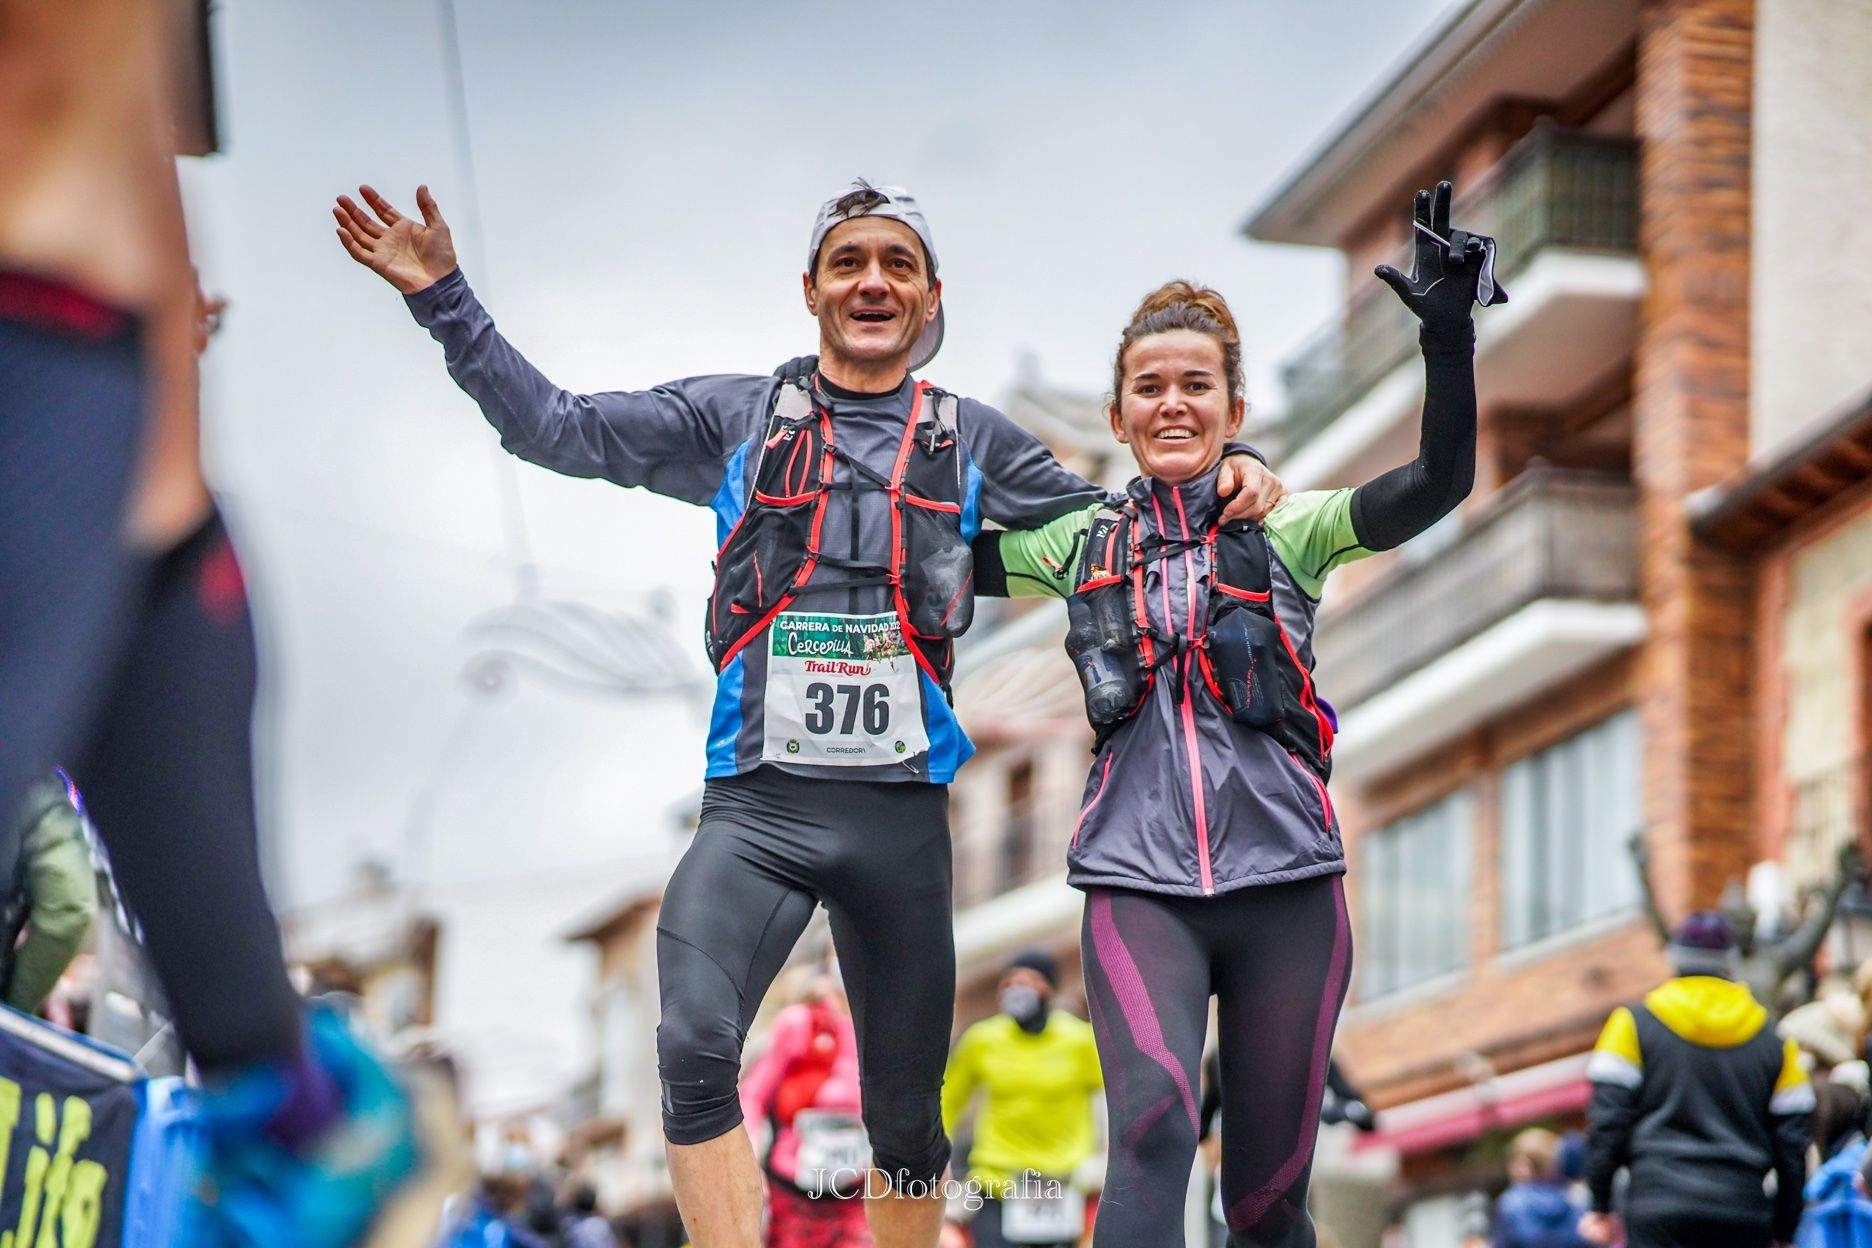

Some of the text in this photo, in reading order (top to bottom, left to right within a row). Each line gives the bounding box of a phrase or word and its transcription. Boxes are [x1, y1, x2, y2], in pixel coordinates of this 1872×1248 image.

[780, 620, 830, 632] CARRERA
[832, 624, 843, 633] DE
[845, 622, 889, 634] NAVIDAD
[804, 660, 871, 677] Trail Run
[805, 682, 890, 736] 376
